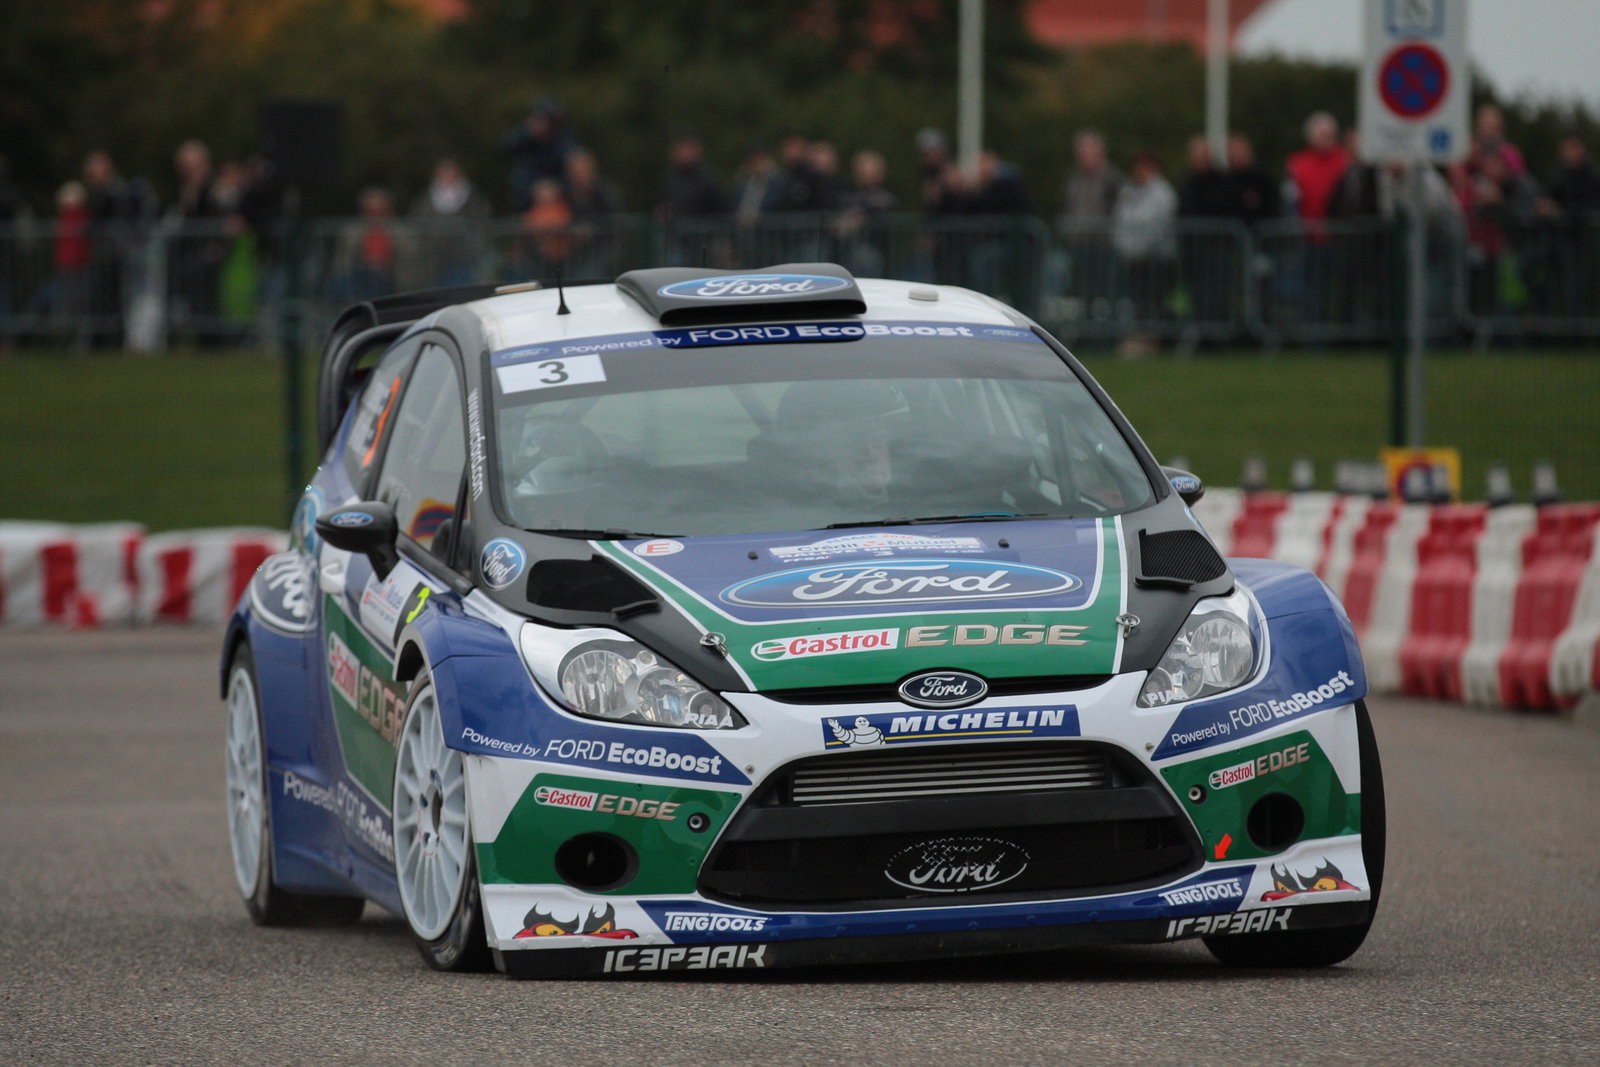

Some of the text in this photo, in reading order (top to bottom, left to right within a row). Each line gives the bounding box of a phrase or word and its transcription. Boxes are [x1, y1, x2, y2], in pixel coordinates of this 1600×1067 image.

[697, 275, 814, 299] Ford
[561, 337, 652, 354] Powered
[656, 335, 681, 350] by
[689, 326, 790, 343] FORD
[796, 323, 974, 338] EcoBoost
[538, 361, 569, 384] 3
[483, 544, 516, 583] Ford
[645, 541, 670, 555] E
[792, 563, 1009, 599] Ford
[789, 624, 1091, 656] Castrol EDGE
[919, 676, 968, 697] Ford
[890, 709, 1065, 733] MICHELIN
[1172, 670, 1354, 746] Powered by FORD EcoBoost
[462, 727, 721, 775] Powered by FORD EcoBoost
[1222, 742, 1311, 785] Castrol EDGE
[548, 790, 683, 821] Castrol EDGE
